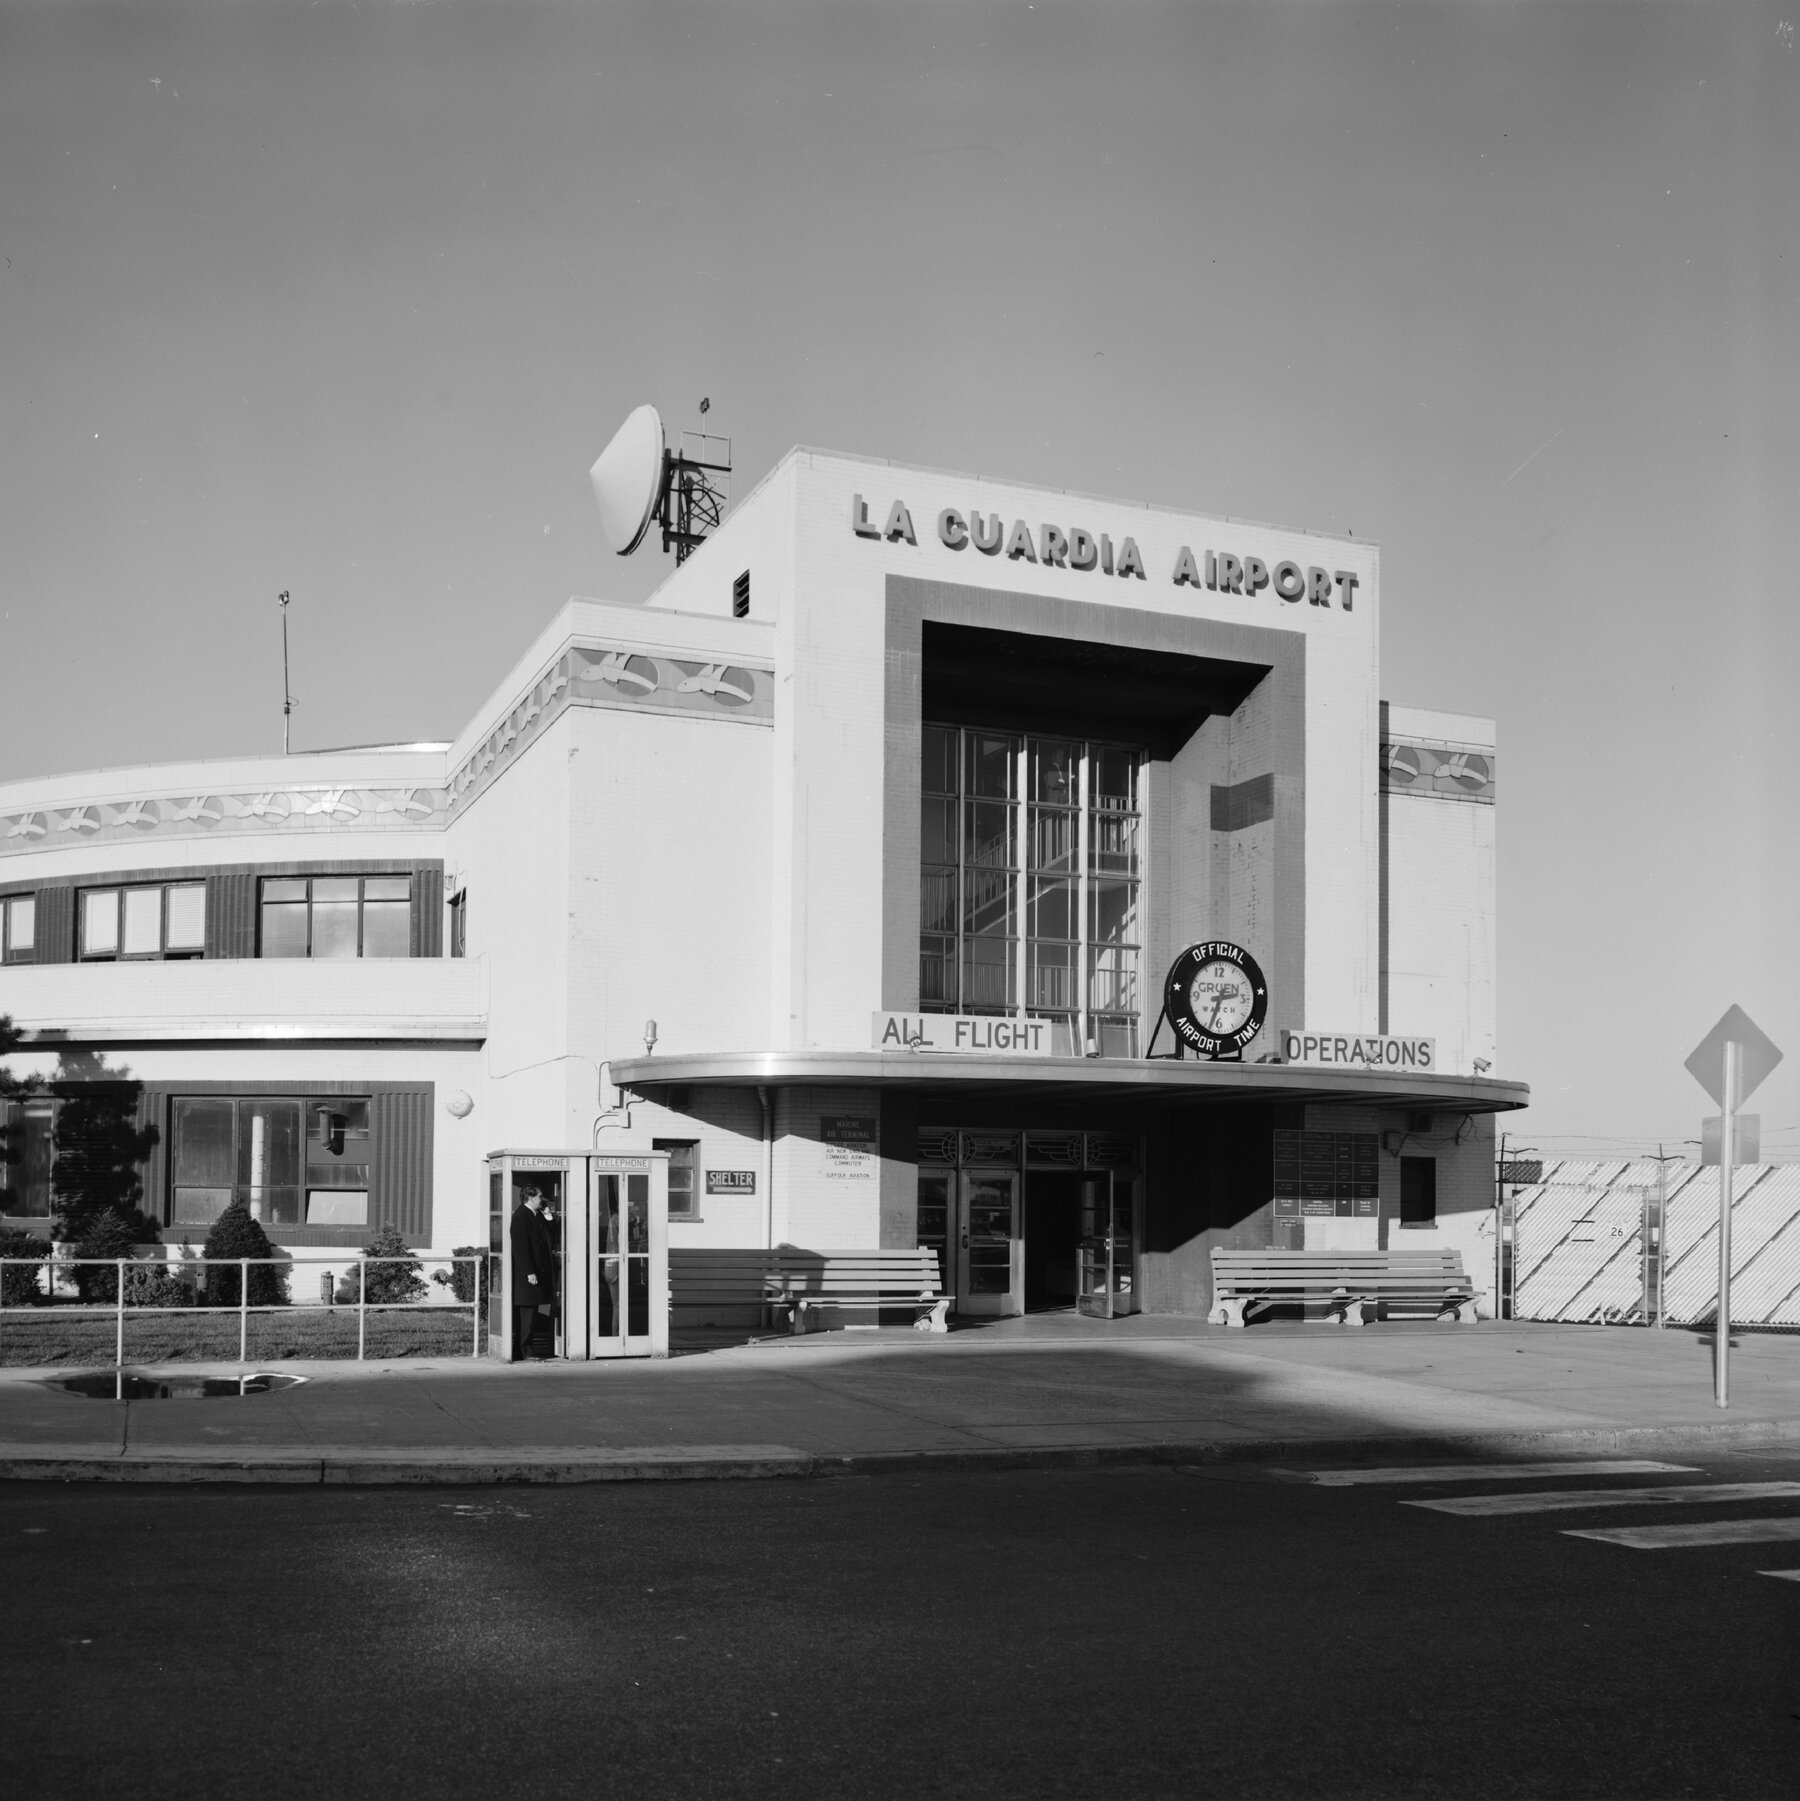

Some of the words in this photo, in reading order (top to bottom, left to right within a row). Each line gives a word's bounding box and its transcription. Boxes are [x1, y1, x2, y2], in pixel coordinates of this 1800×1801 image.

[852, 493, 918, 546] LA
[937, 507, 1146, 581] GUARDIA
[1172, 545, 1359, 612] AIRPORT
[1192, 943, 1243, 964] OFFICIAL
[1214, 967, 1225, 978] 12
[1198, 982, 1239, 994] GRUEN
[1193, 991, 1200, 1002] 9
[1239, 994, 1246, 1004] 3
[1215, 1017, 1222, 1029] 6
[882, 1017, 934, 1046] ALL
[955, 1021, 1043, 1050] FLIGHT
[1176, 1017, 1222, 1052] AIRPORT
[1233, 1018, 1260, 1047] TIME
[1286, 1035, 1431, 1067] OPERATIONS
[516, 1157, 566, 1167] TELEPHONE
[600, 1158, 648, 1168] TELEPHONE
[708, 1171, 753, 1186] SHELTER
[1611, 1227, 1623, 1237] 26
